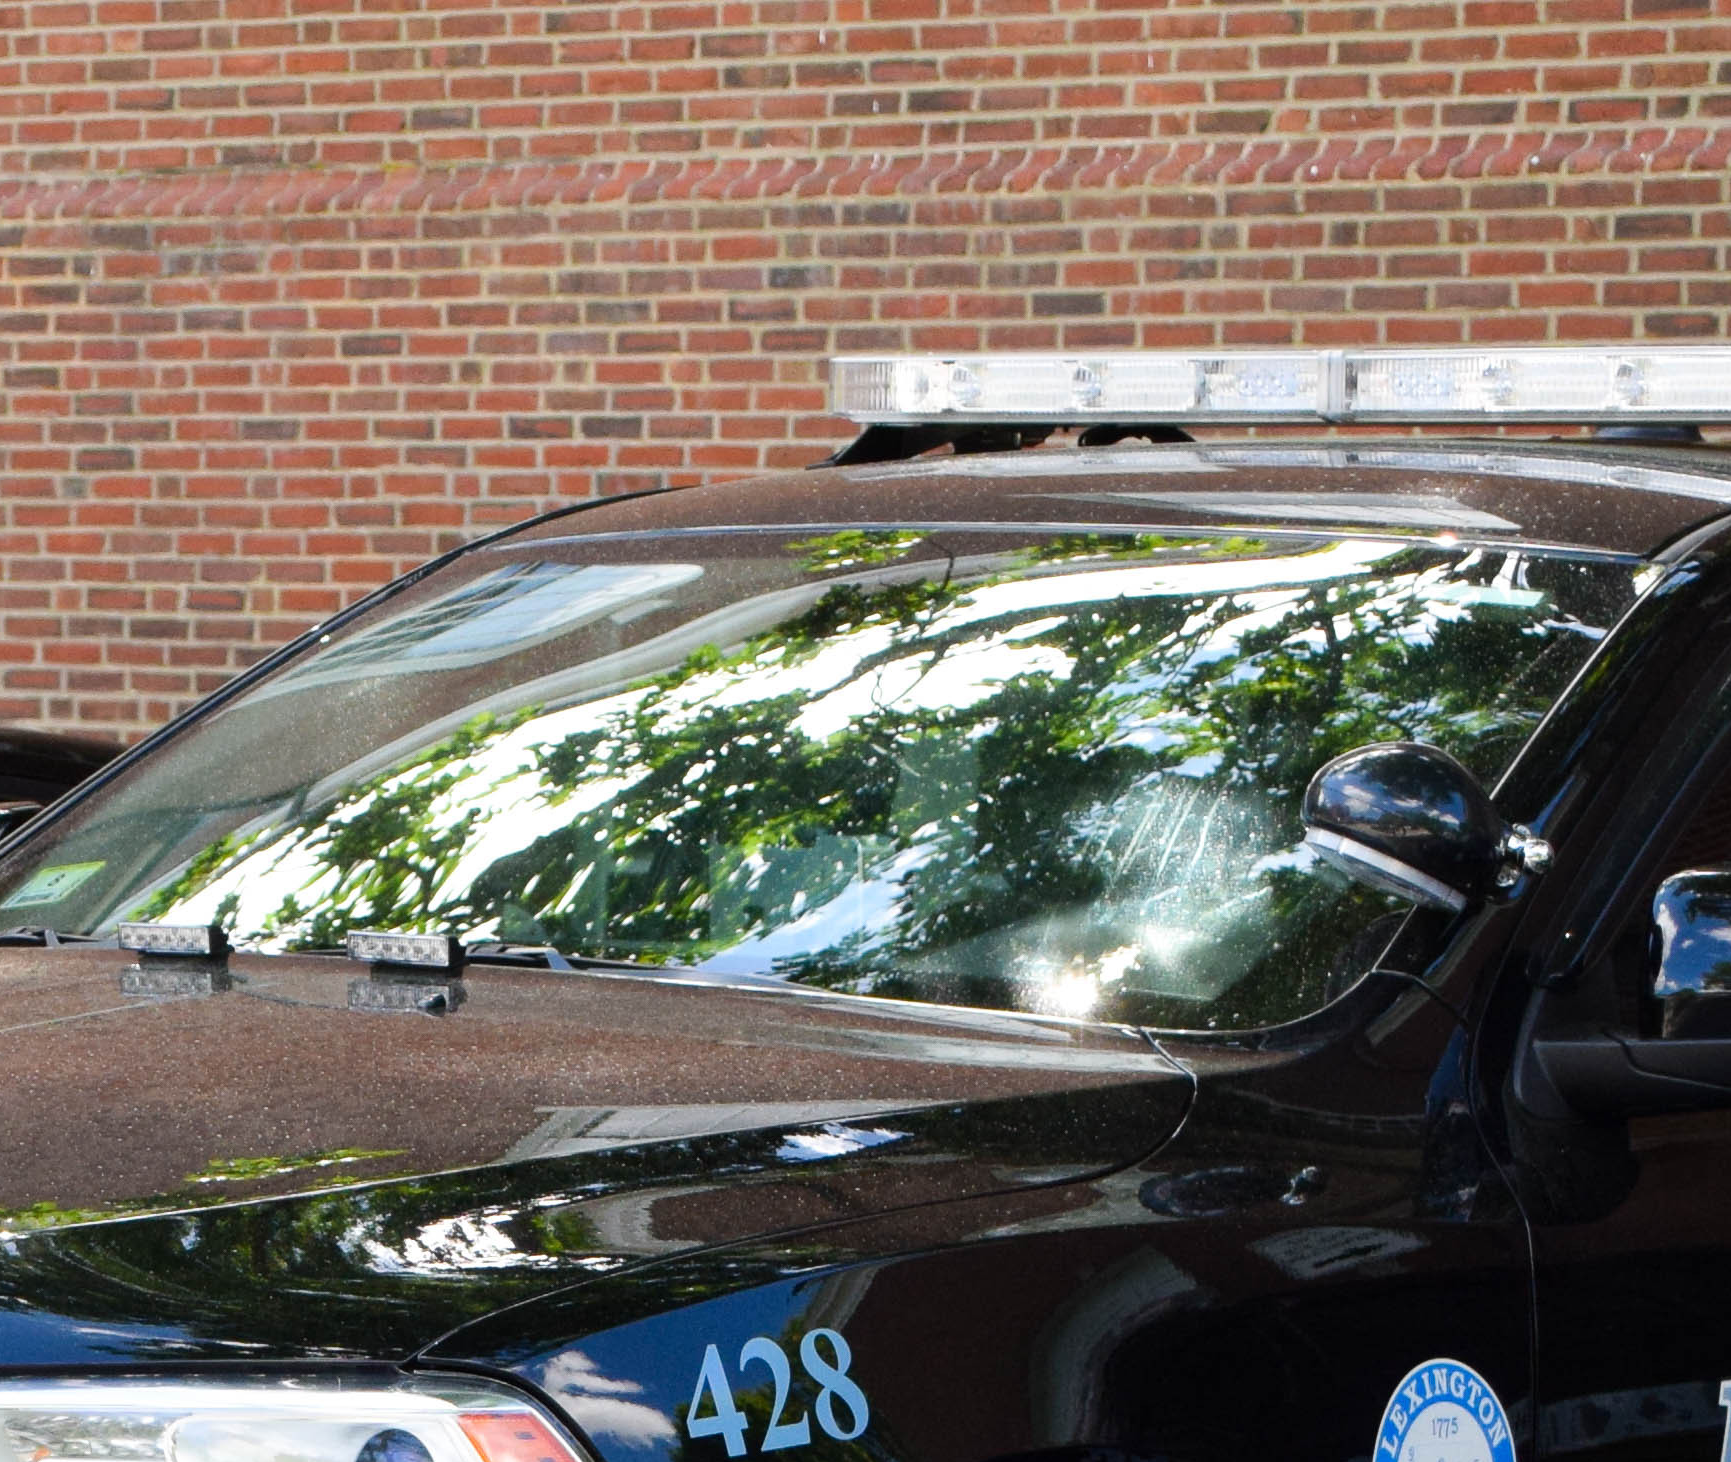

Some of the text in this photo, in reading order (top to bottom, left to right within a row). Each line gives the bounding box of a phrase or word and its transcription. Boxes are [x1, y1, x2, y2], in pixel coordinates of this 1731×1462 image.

[686, 1327, 870, 1458] 428
[1379, 1368, 1508, 1459] LEXINGTON
[1431, 1416, 1460, 1440] 1775
